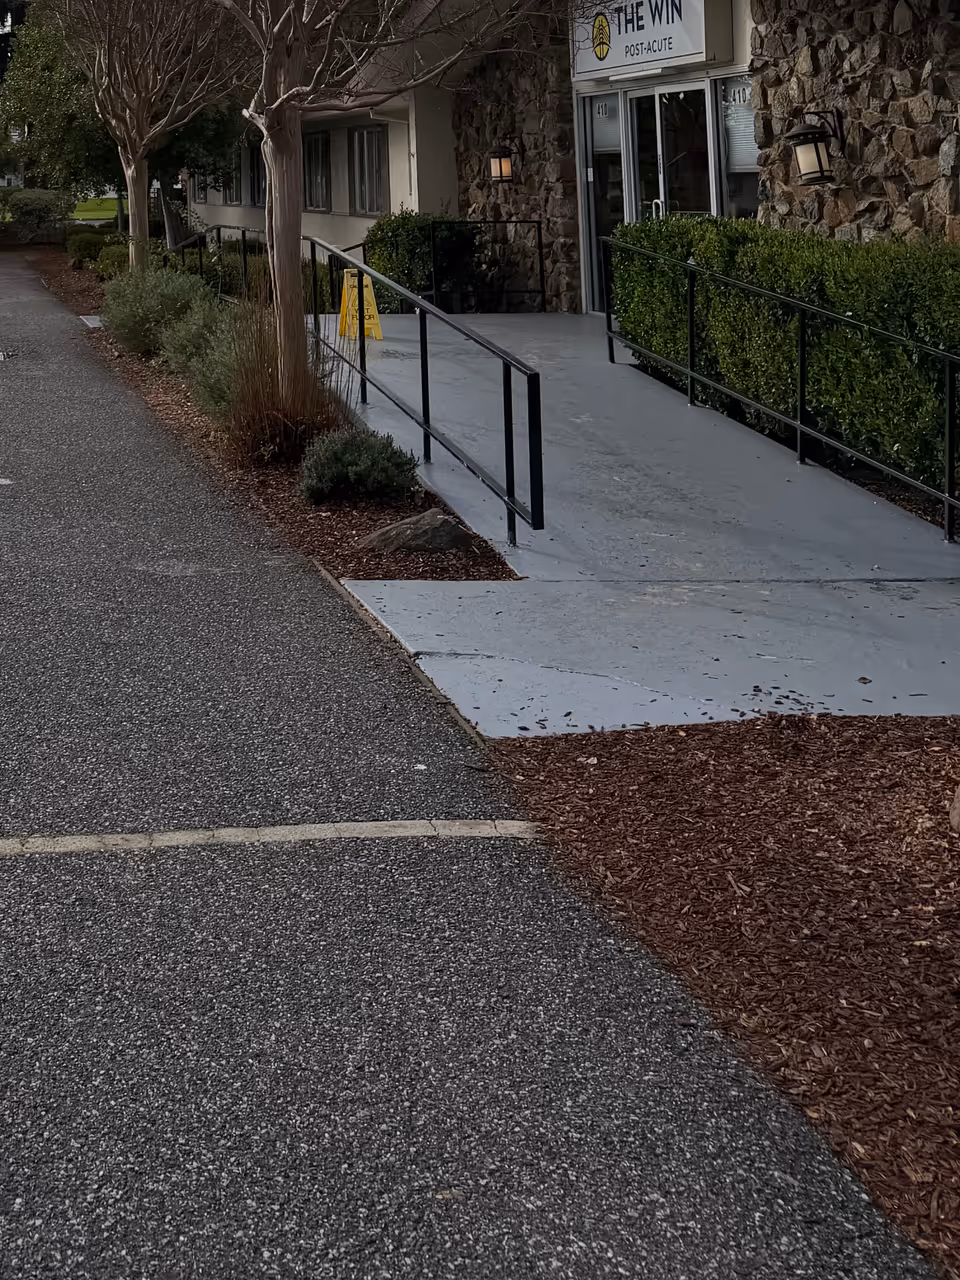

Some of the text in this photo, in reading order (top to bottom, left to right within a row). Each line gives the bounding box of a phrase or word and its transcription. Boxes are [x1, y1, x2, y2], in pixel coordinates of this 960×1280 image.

[615, 1, 645, 35] THE
[625, 37, 672, 57] POST-ACUTE
[731, 87, 747, 104] 410
[596, 102, 608, 118] 410
